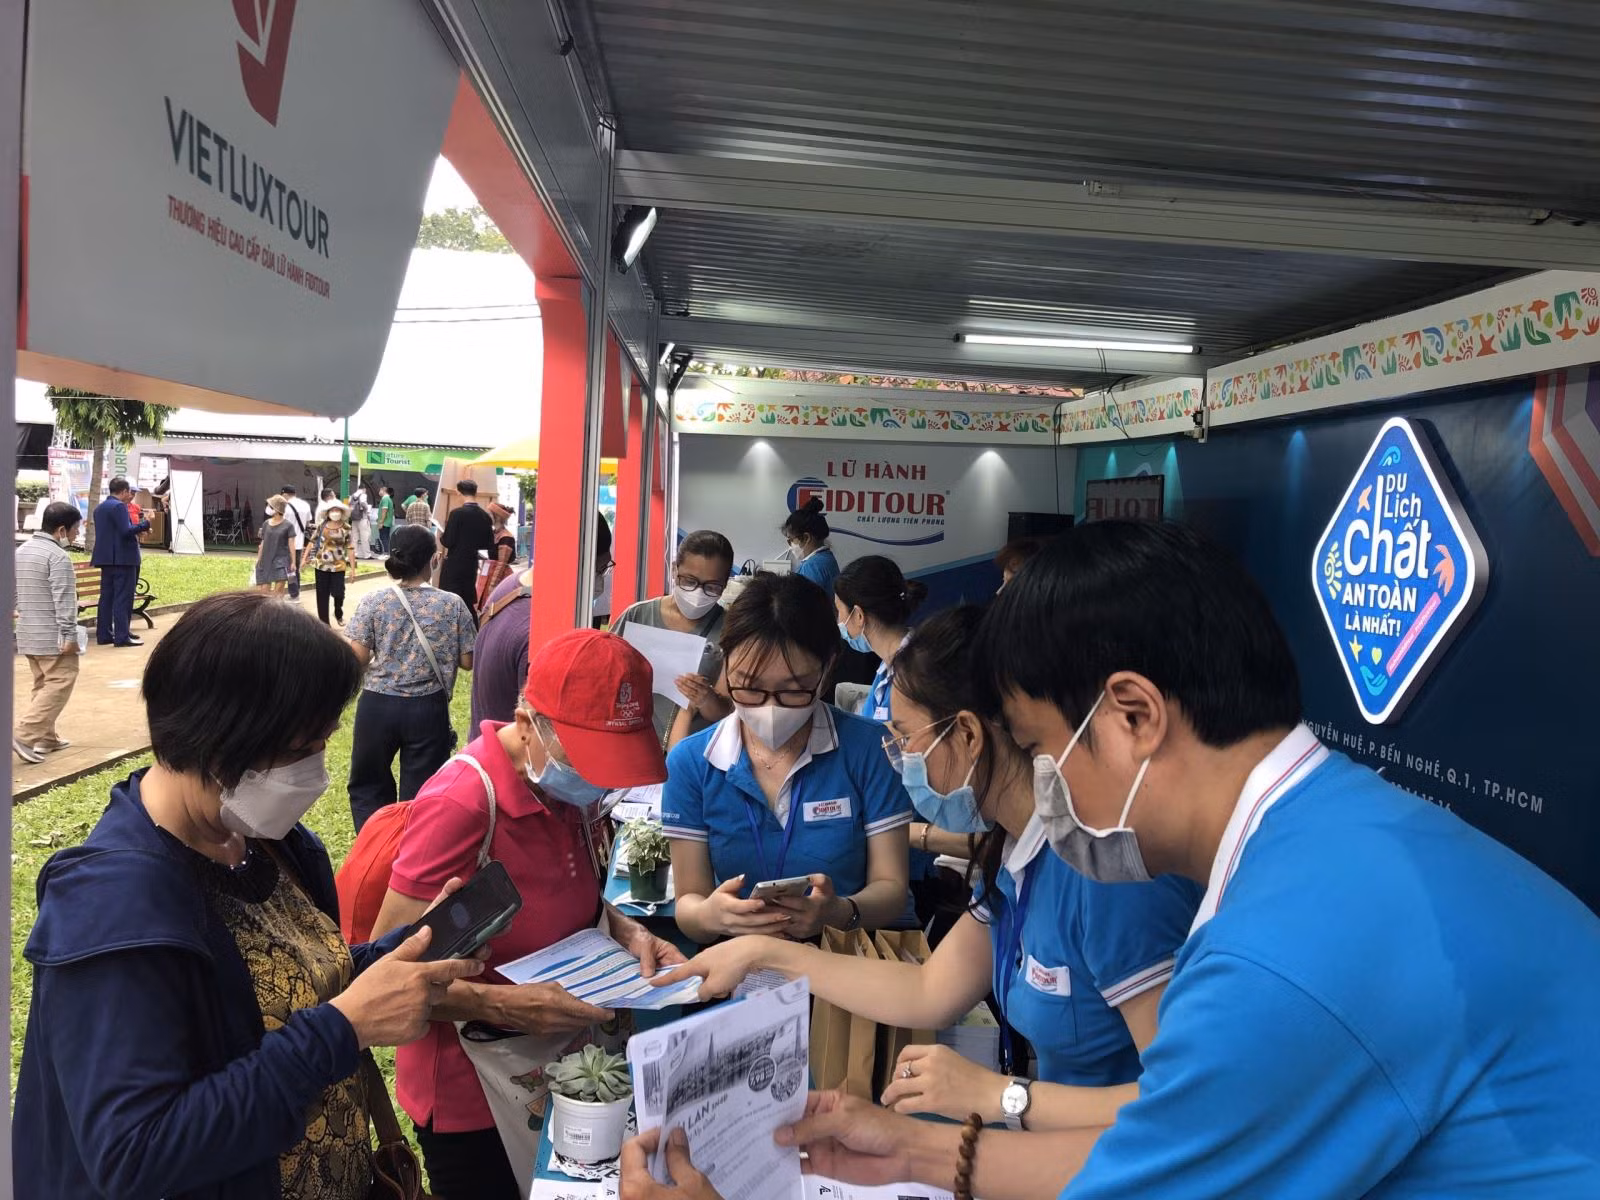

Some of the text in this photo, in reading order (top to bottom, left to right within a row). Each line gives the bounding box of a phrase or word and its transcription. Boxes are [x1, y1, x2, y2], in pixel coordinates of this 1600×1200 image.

[163, 95, 329, 258] VIETLUXTOUR
[167, 194, 205, 235] THƯƠNG
[207, 216, 226, 248] HIỆU
[228, 229, 244, 256] CAO
[246, 236, 260, 263] CẤP
[261, 244, 275, 272] CỦA
[115, 439, 127, 480] OURIS
[386, 457, 411, 465] Tourist
[827, 459, 926, 481] LỮ HÀNH
[1386, 473, 1408, 493] DU
[1383, 492, 1422, 524] Lịch
[1343, 474, 1432, 580] Chất
[1341, 580, 1417, 612] AN TOÀN
[1344, 610, 1361, 631] LÀ
[1362, 612, 1401, 637] NHẤT!
[1483, 779, 1543, 814] TP.HCM
